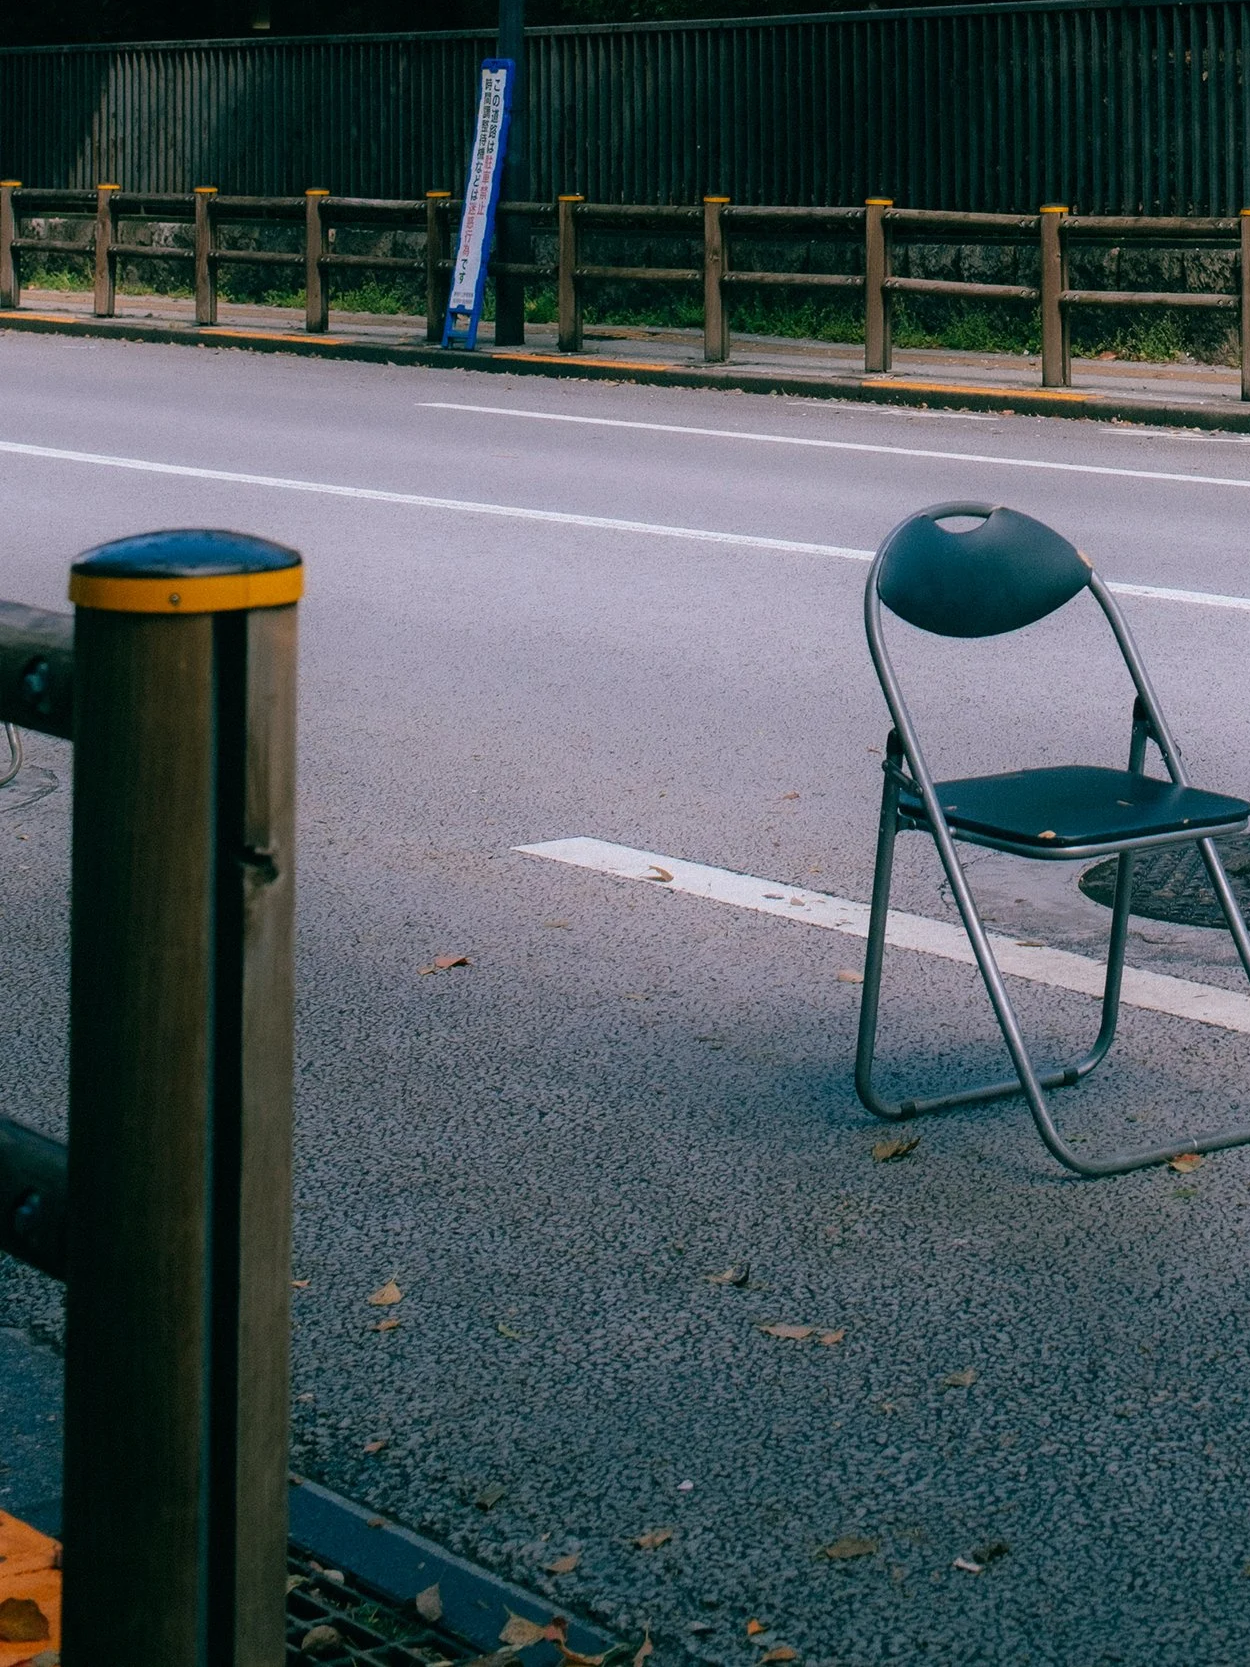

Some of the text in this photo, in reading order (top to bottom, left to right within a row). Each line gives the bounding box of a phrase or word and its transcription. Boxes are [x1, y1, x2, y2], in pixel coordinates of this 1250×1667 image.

[477, 79, 501, 215] この道路は駐車禁止
